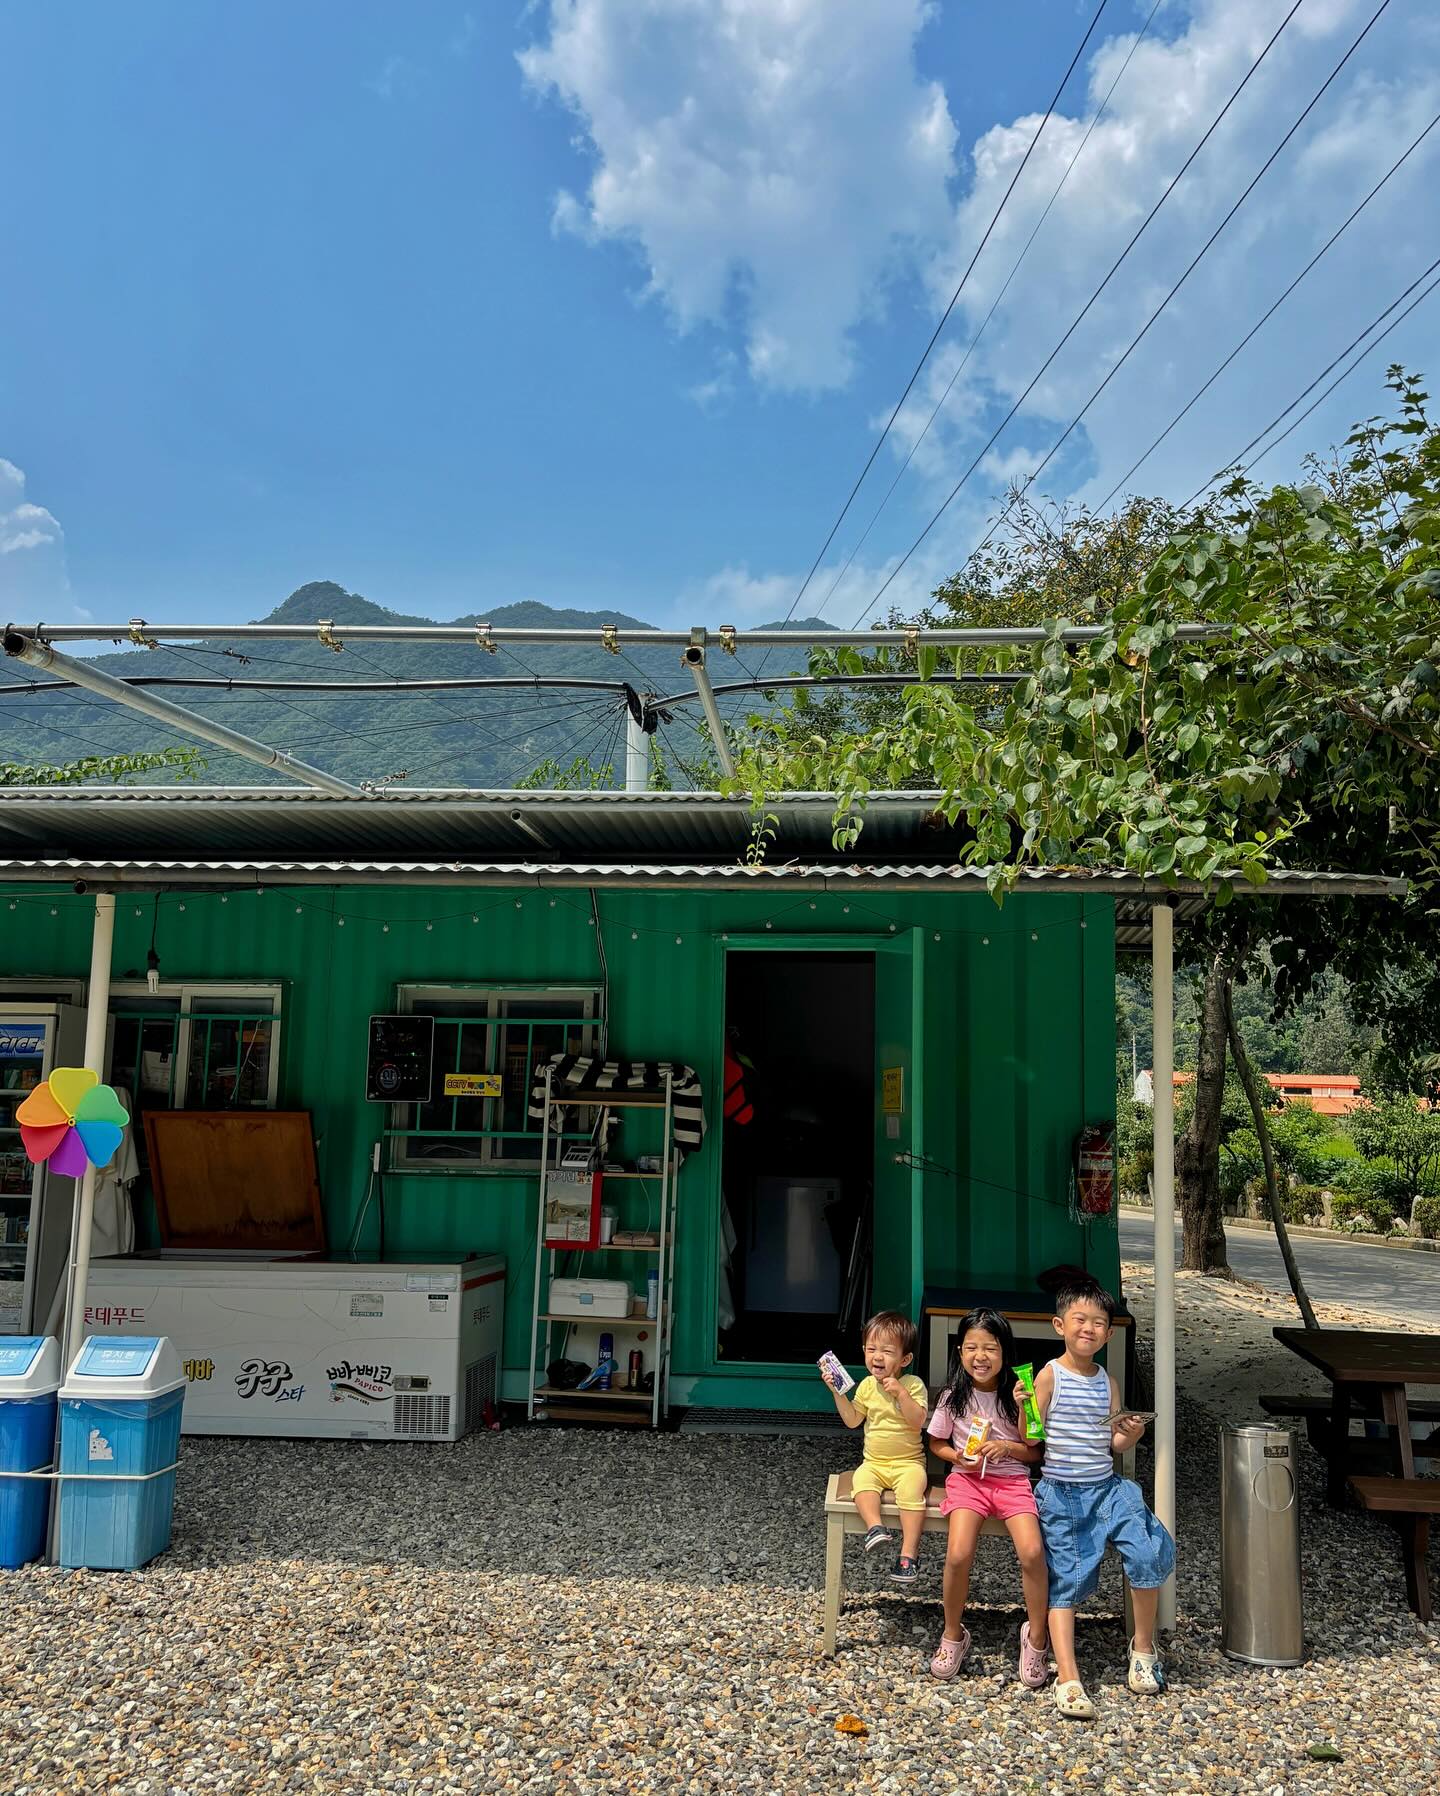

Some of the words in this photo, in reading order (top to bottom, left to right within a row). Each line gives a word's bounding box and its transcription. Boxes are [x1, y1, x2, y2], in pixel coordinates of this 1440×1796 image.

[446, 1078, 467, 1089] CCTV
[235, 1358, 293, 1399] 구구
[326, 1360, 392, 1386] 빠삐코
[275, 1385, 306, 1402] 스타
[354, 1378, 384, 1393] PAPICO
